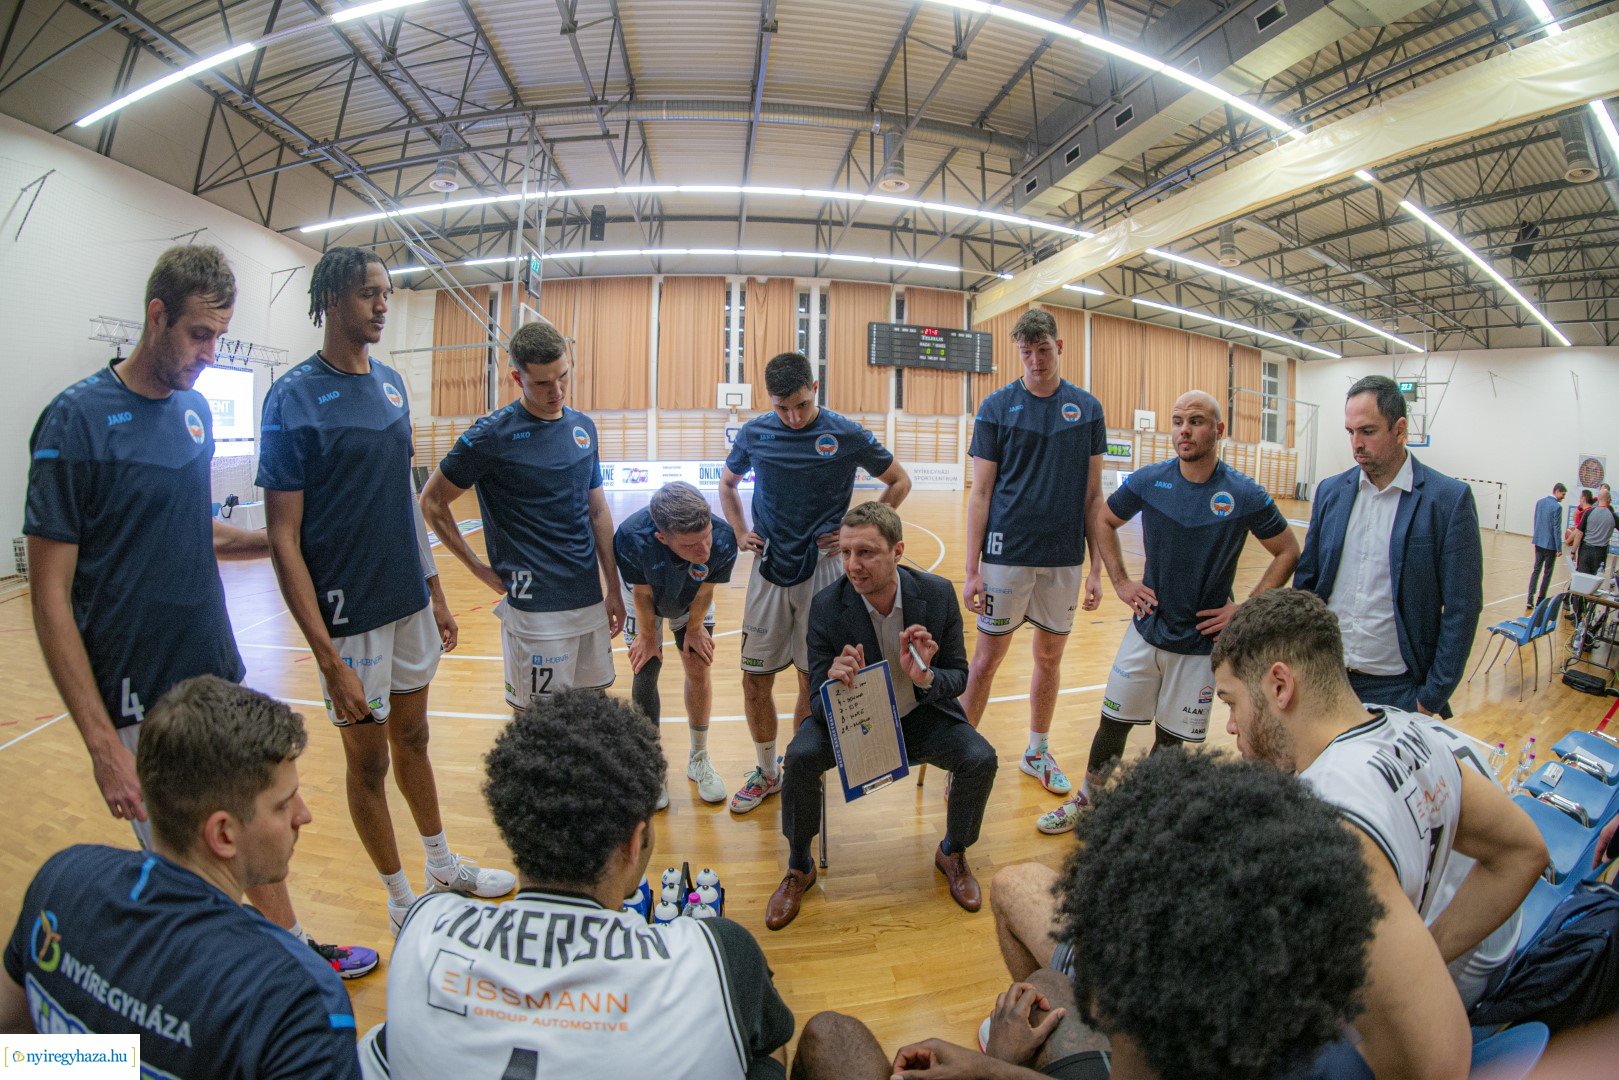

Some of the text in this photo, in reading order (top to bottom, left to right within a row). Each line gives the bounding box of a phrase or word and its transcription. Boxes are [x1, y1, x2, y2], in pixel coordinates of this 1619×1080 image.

[318, 390, 340, 405] JAKO
[107, 411, 133, 426] JAKO
[512, 431, 531, 440] JAKO
[760, 433, 776, 441] JAKO
[1154, 480, 1173, 490] JAKO
[986, 532, 1004, 555] 16
[511, 570, 533, 599] 12
[327, 589, 349, 625] 2
[531, 667, 553, 694] 12
[121, 677, 146, 722] 4
[60, 952, 192, 1048] NYÍREGYHÁZA
[441, 968, 630, 1015] EISSMANN
[473, 1005, 629, 1032] GROUP AUTOMOTIVE
